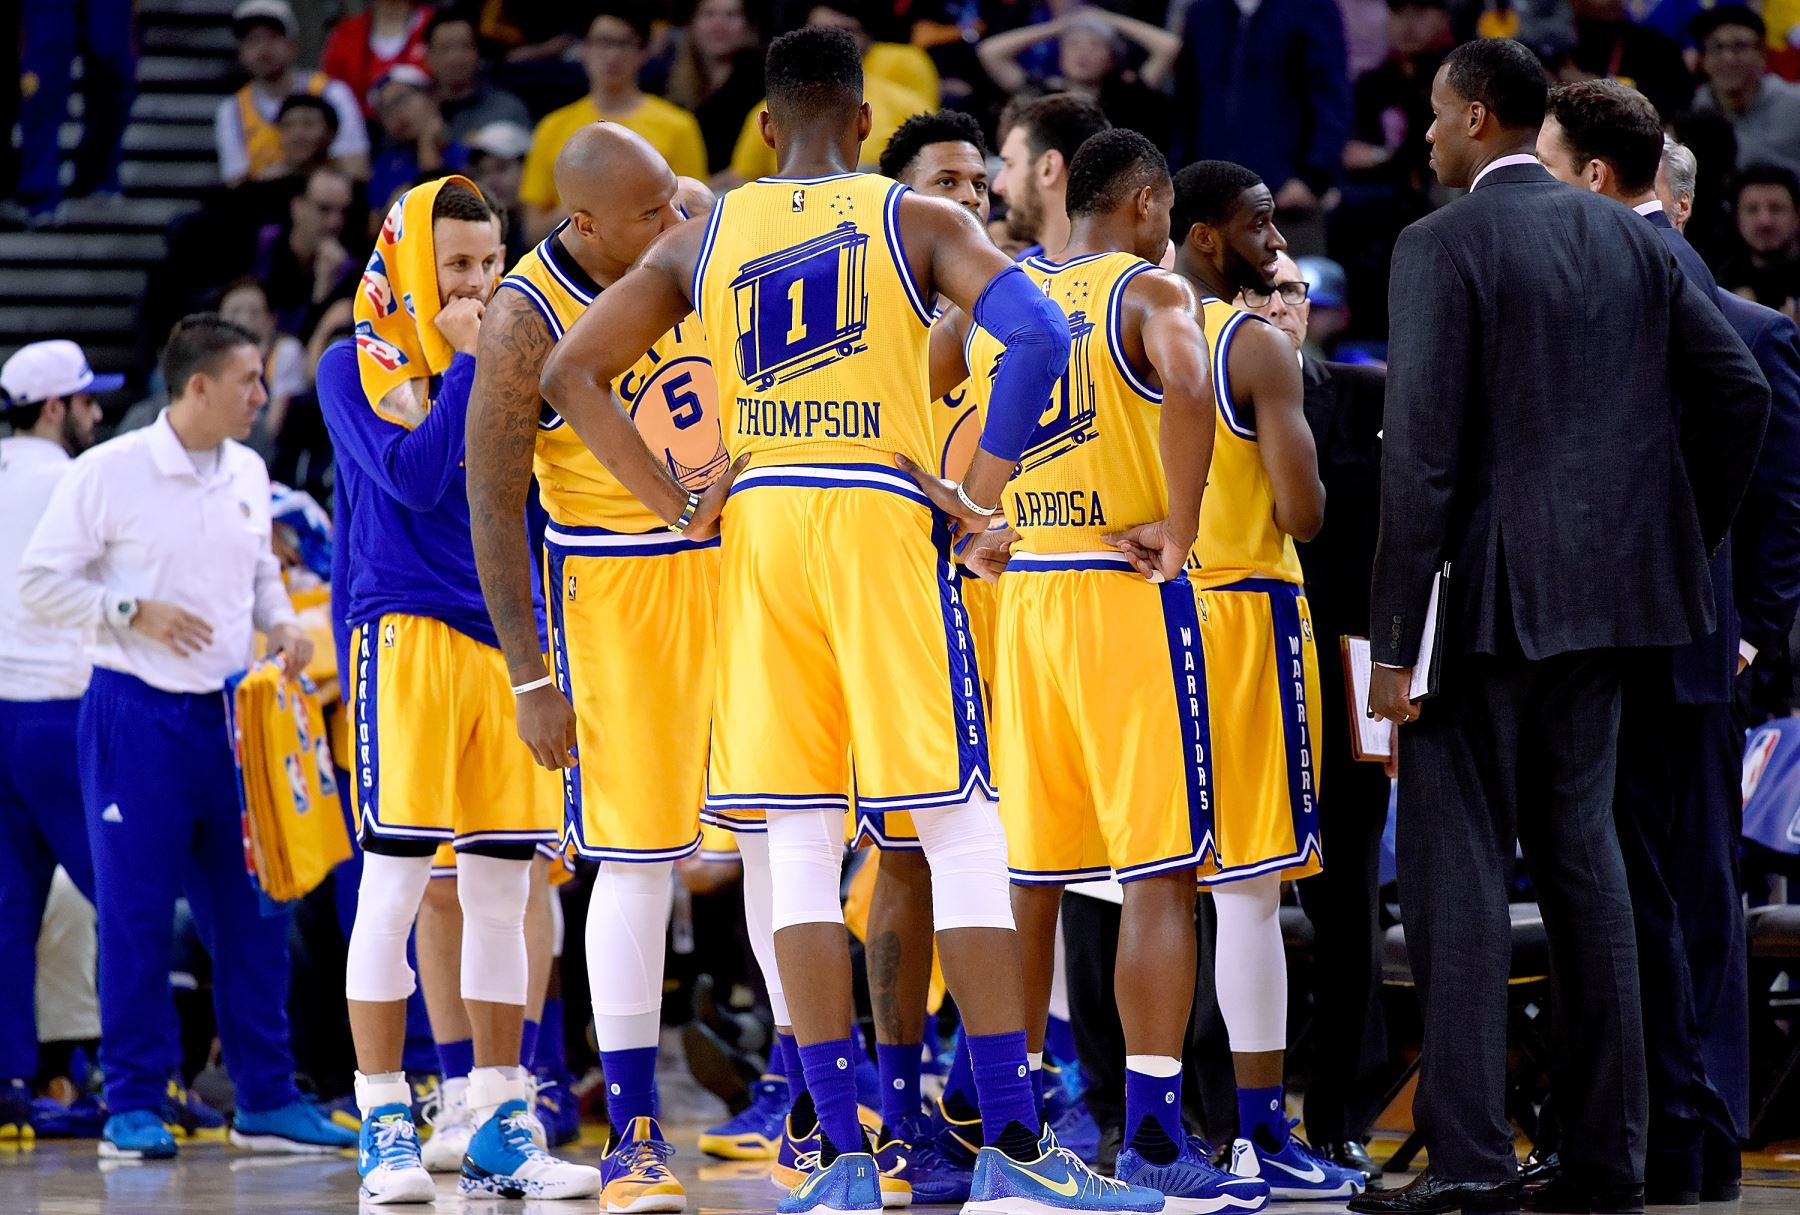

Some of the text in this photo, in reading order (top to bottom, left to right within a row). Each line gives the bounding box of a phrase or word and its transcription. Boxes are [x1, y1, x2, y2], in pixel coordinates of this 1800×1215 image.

[786, 278, 807, 345] 1
[619, 318, 706, 402] CIT
[662, 371, 703, 431] 5
[736, 397, 881, 438] THOMPSON
[947, 561, 978, 745] WARRIORS
[1180, 627, 1208, 810] WARRIORS
[1288, 636, 1312, 813] WARRIORS
